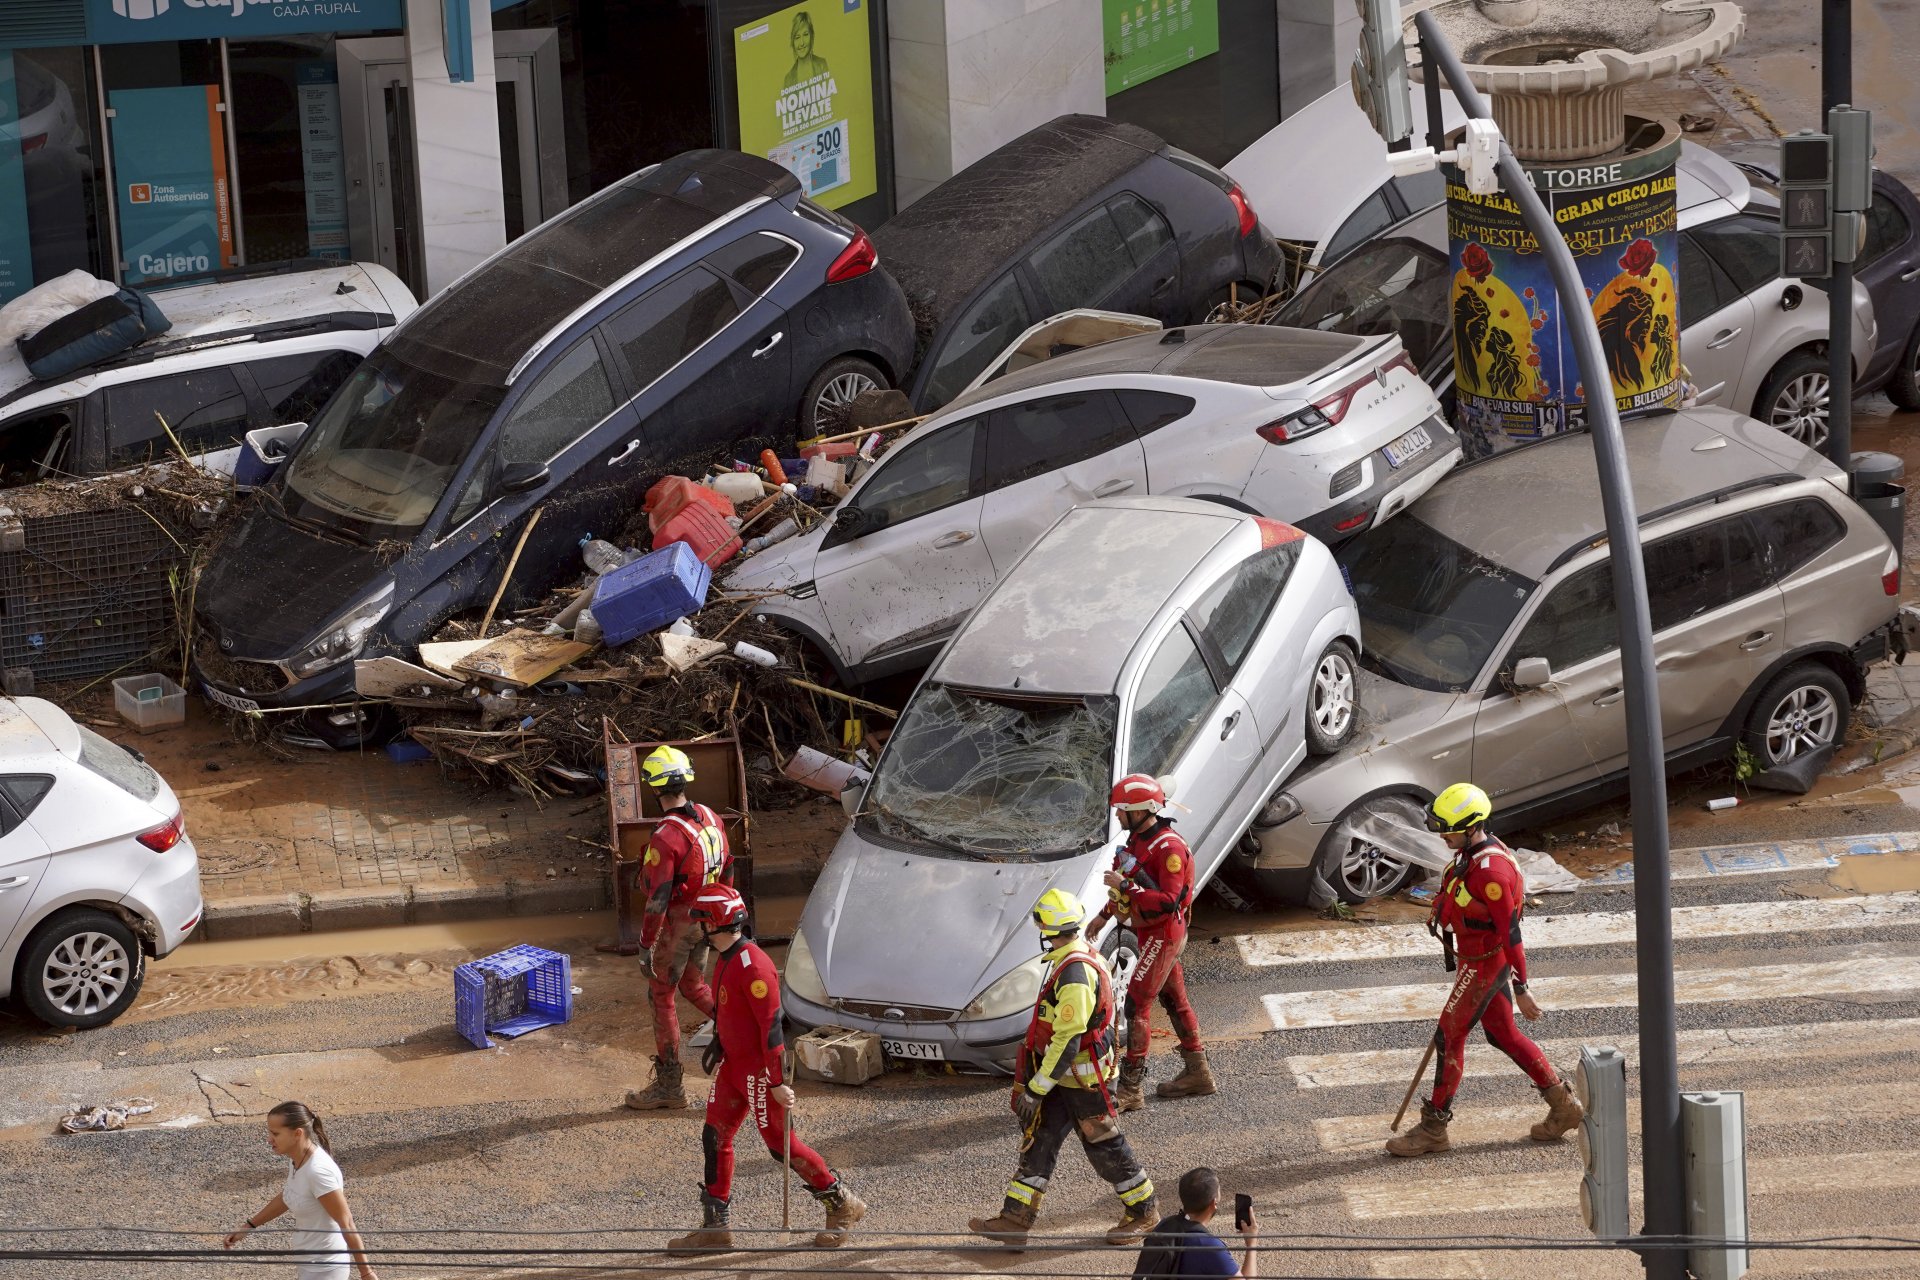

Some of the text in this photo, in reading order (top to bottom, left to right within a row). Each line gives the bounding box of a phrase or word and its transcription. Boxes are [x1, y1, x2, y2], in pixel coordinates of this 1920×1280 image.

[273, 5, 309, 18] CAJA
[314, 2, 361, 15] RURAL
[775, 78, 838, 117] NOMINA
[781, 97, 832, 130] LLEVATE
[816, 126, 841, 156] 500
[820, 148, 842, 161] EURAZOS
[1543, 163, 1622, 188] TORRE
[153, 185, 175, 194] Zona
[153, 192, 209, 203] Autoservicio
[217, 178, 229, 242] Zona Autoservicio
[1555, 196, 1605, 224] GRAN
[1606, 183, 1649, 207] CIRCO
[1448, 215, 1469, 241] ELLA
[1479, 227, 1541, 252] BESTIA
[1569, 225, 1633, 250] BELLA
[138, 253, 209, 277] Cajero
[1367, 383, 1406, 410] ARKANA
[1512, 402, 1534, 415] SUR
[1616, 398, 1633, 411] CIA
[1633, 384, 1669, 408] BULEVAR
[1391, 428, 1430, 460] 4182 LZK
[882, 1040, 938, 1058] 28 CYY
[746, 1074, 756, 1113] MBERS
